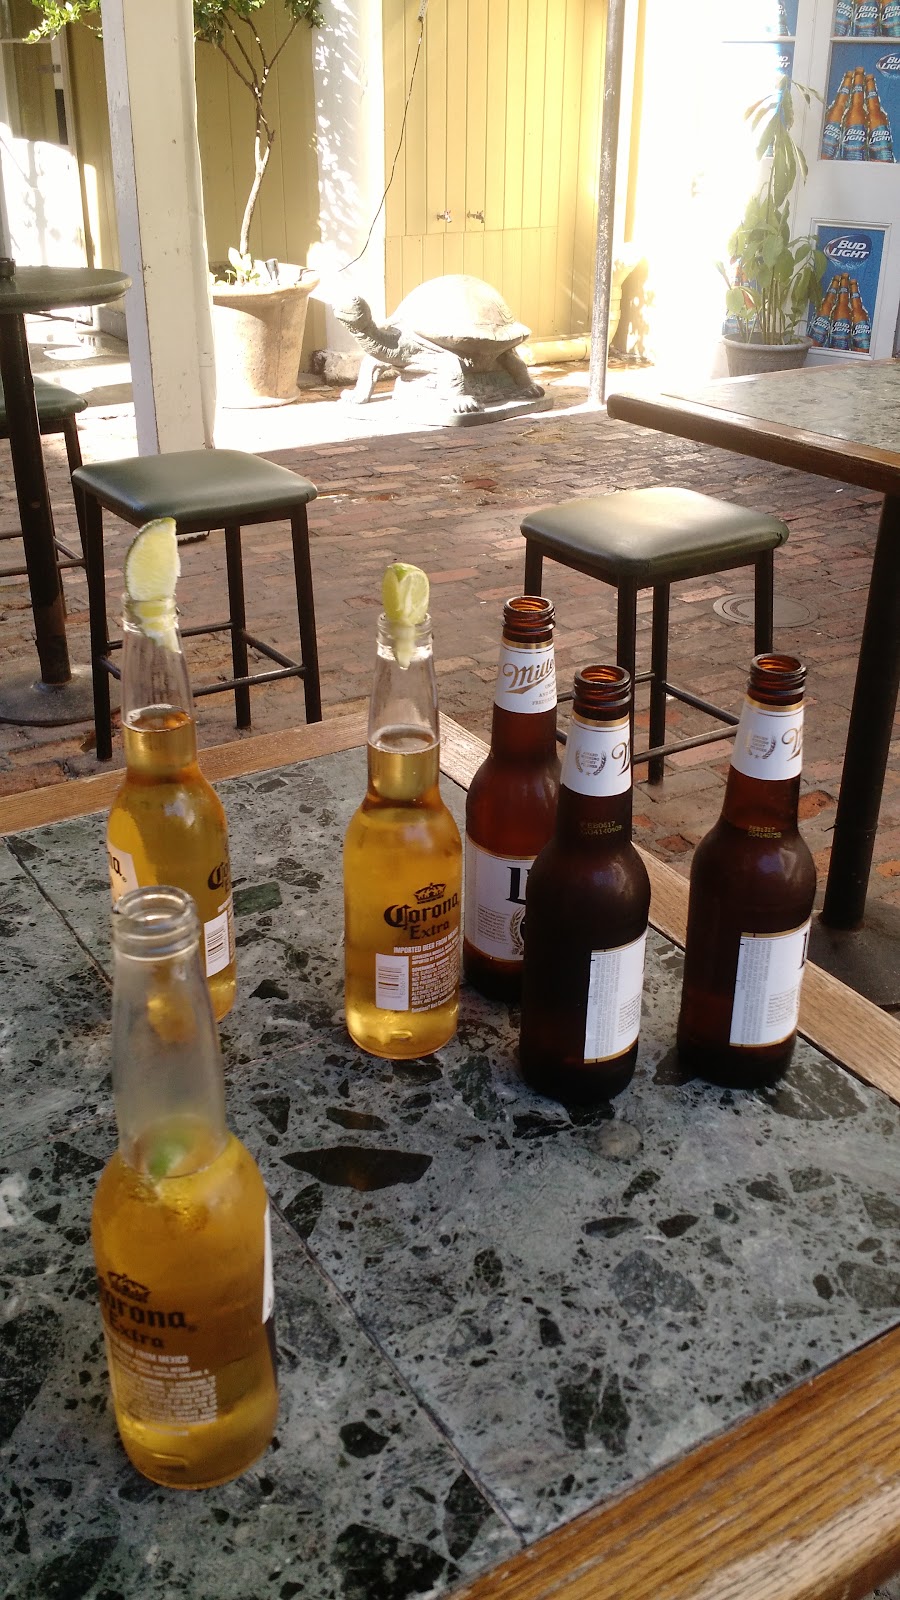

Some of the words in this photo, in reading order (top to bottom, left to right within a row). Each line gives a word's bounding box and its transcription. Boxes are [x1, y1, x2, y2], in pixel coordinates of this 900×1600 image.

[859, 5, 878, 13] BUD
[854, 11, 879, 20] LIGHT
[846, 128, 866, 136] BUD
[842, 135, 867, 143] LIGHT
[837, 240, 867, 250] BUD
[830, 248, 869, 259] LIGHT
[383, 892, 459, 931] Corona
[409, 920, 450, 940] Extra
